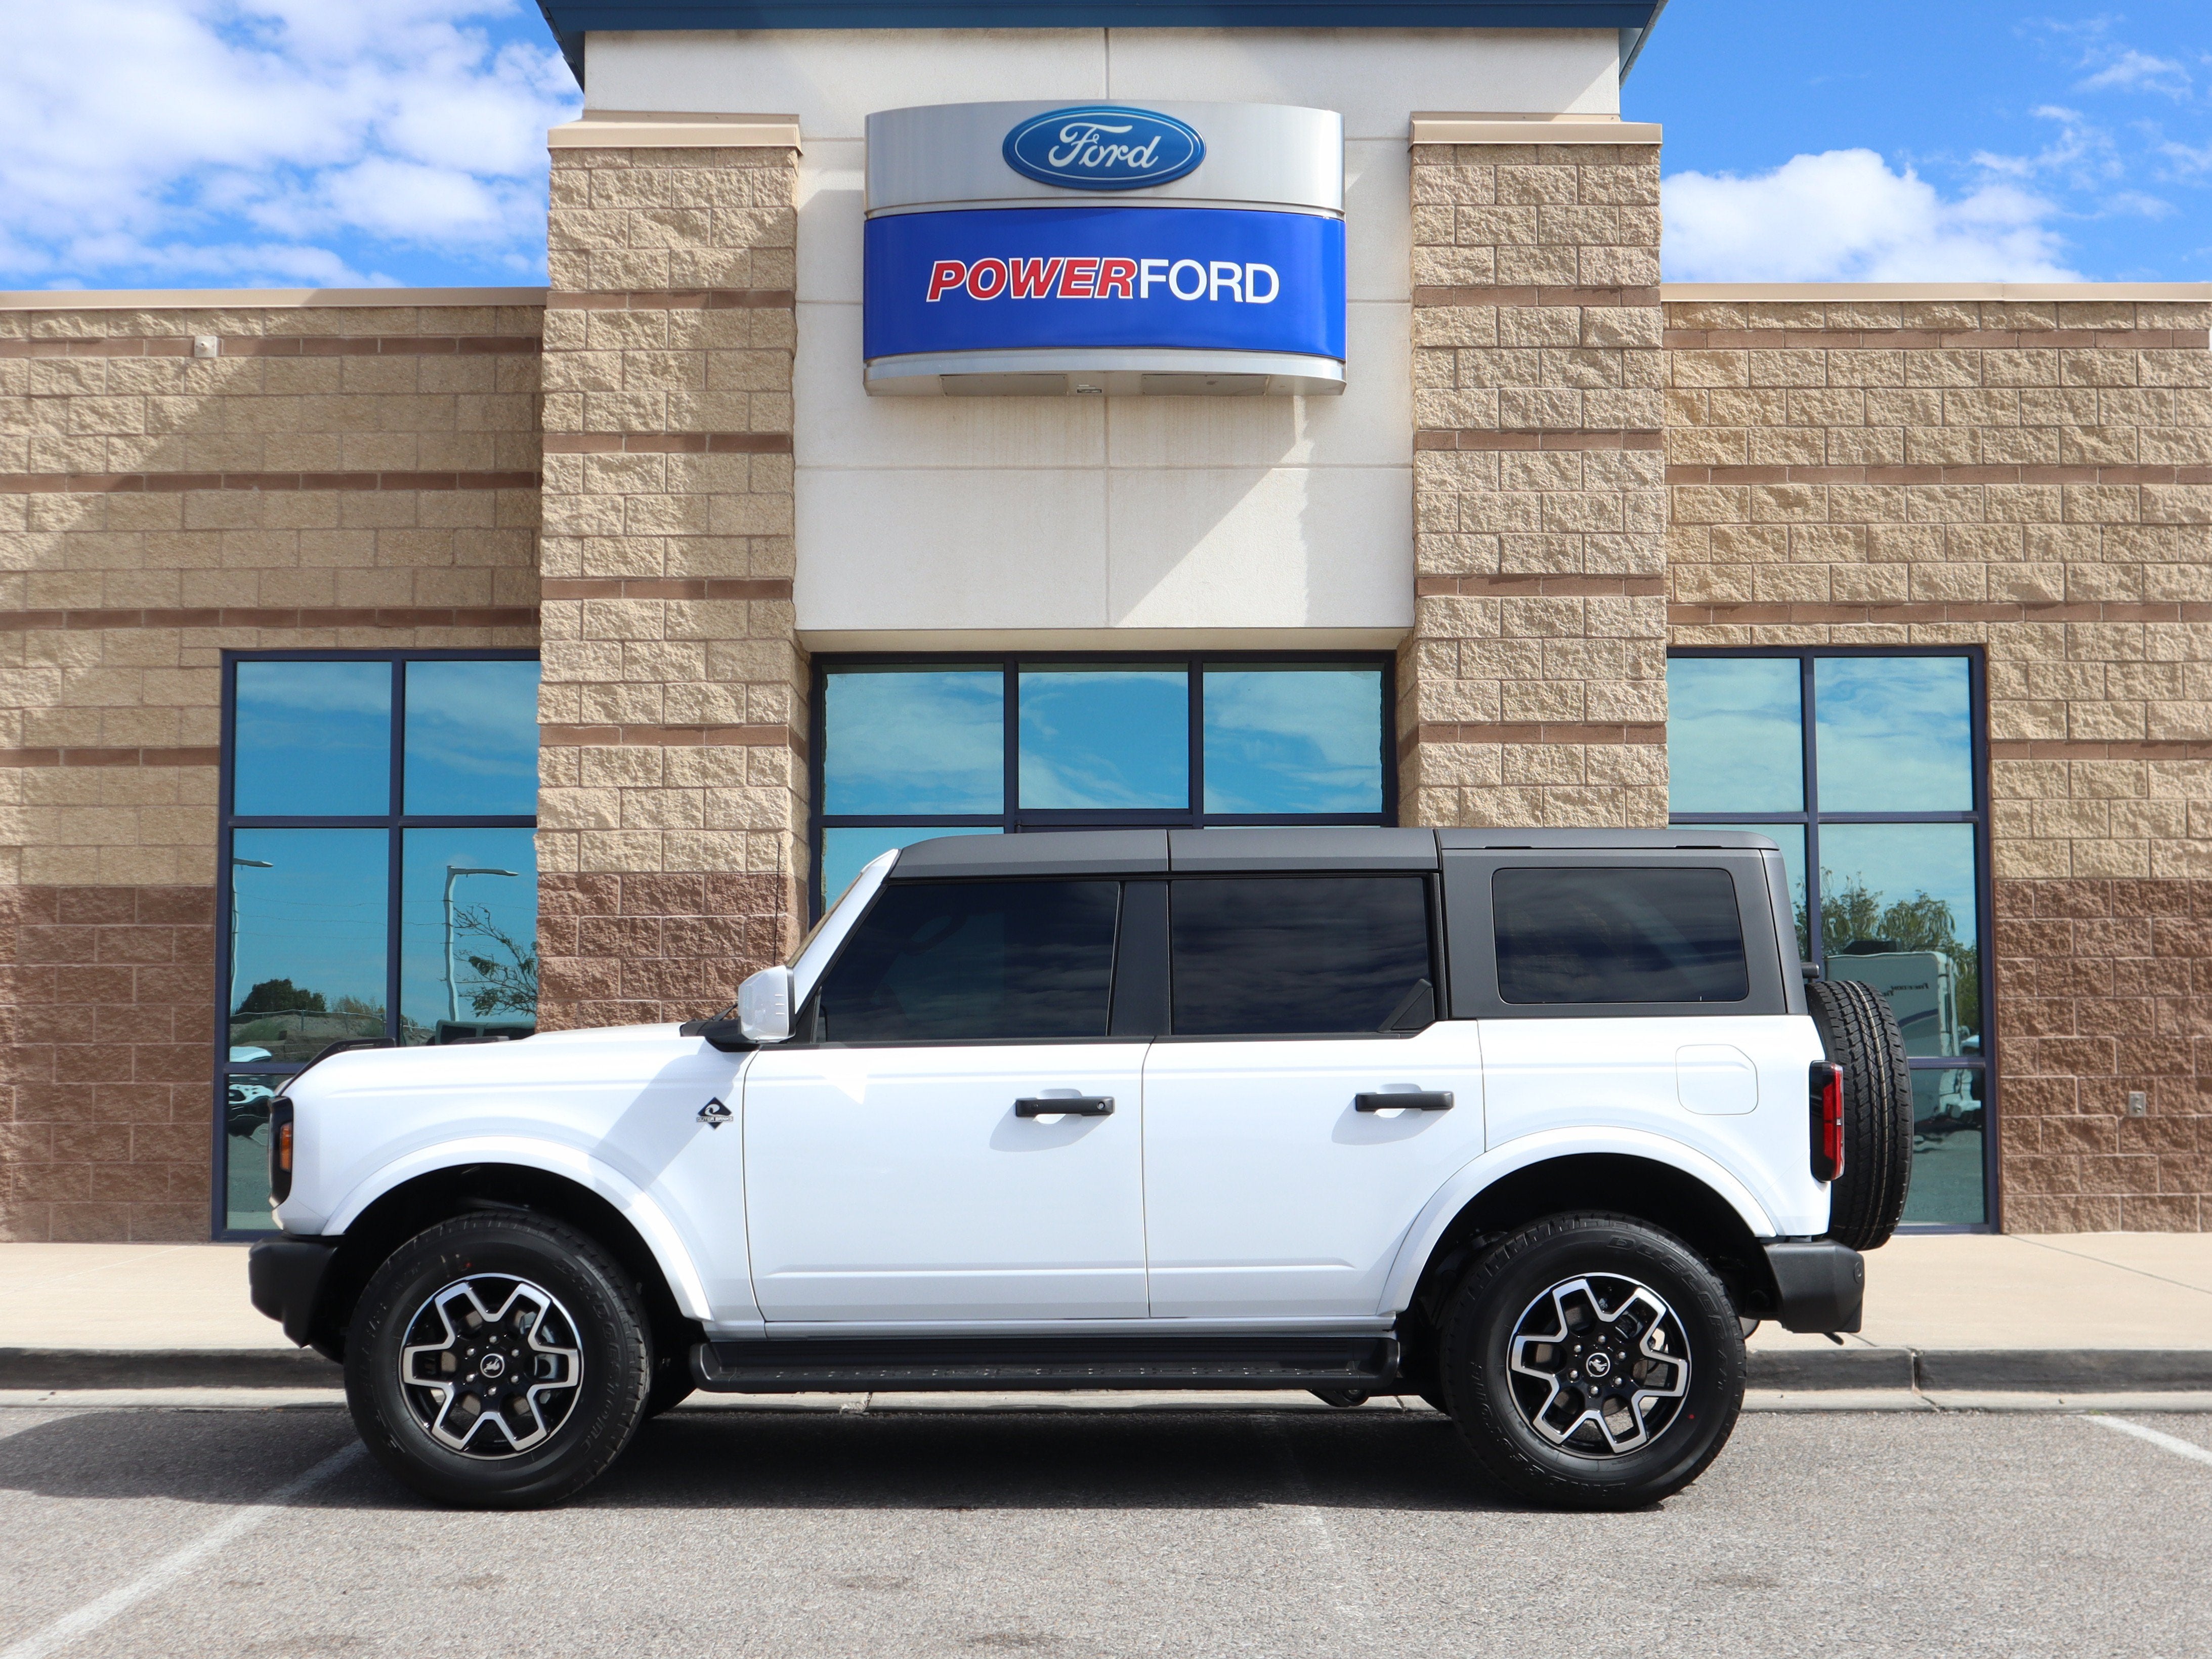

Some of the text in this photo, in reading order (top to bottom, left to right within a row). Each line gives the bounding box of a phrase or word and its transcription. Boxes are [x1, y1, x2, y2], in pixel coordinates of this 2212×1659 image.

[1048, 122, 1161, 168] Ford
[1607, 1235, 1728, 1336] DUELER
[552, 1260, 621, 1456] BRIDGESTONE
